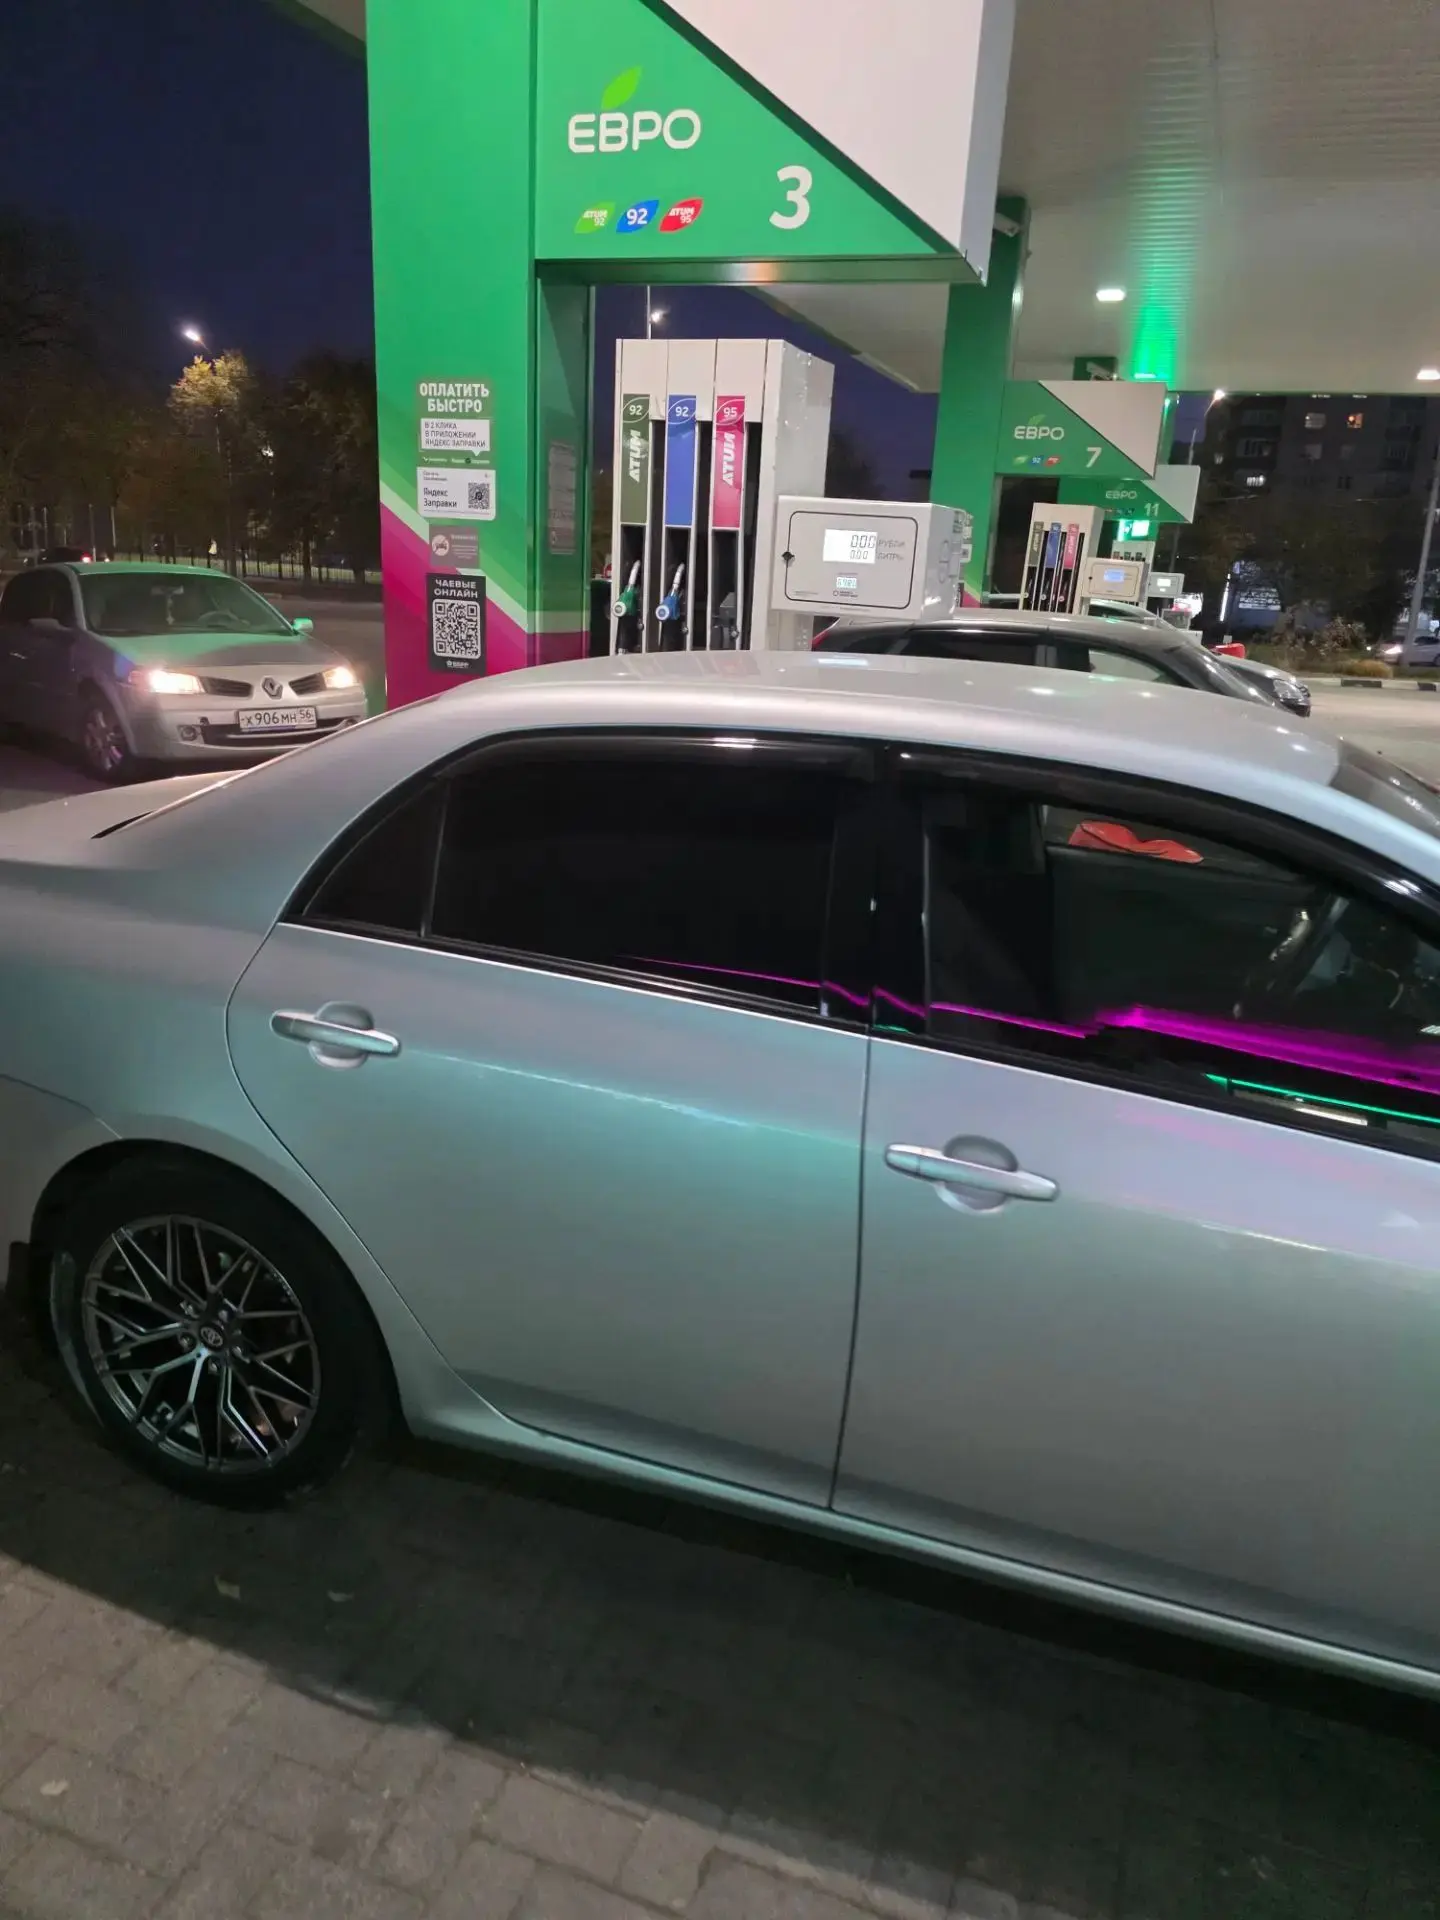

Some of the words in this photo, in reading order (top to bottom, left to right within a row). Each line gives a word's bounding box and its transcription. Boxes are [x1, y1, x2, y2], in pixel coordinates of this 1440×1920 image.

[568, 109, 701, 153] ЕВРО
[769, 165, 813, 230] 3
[626, 207, 648, 226] 92
[668, 207, 695, 217] ATUM
[680, 214, 693, 224] 95
[419, 382, 490, 398] ОПЛАТИТЬ
[427, 398, 483, 413] БЫСТРО
[629, 404, 643, 416] 92
[675, 406, 689, 417] 92
[723, 407, 738, 418] 95
[436, 421, 457, 429] КЛИКА
[430, 430, 477, 439] ПРИЛОЖЕНИИ
[1013, 425, 1065, 441] ЕВРО
[629, 428, 642, 482] ATUM
[722, 432, 736, 486] ATUM
[1086, 446, 1102, 468] 7
[423, 487, 449, 497] Яндекс
[423, 498, 458, 509] Заправки
[1144, 502, 1160, 517] 11
[435, 578, 477, 589] ЧАЕВЫЕ
[433, 588, 478, 599] ОНЛАЙН
